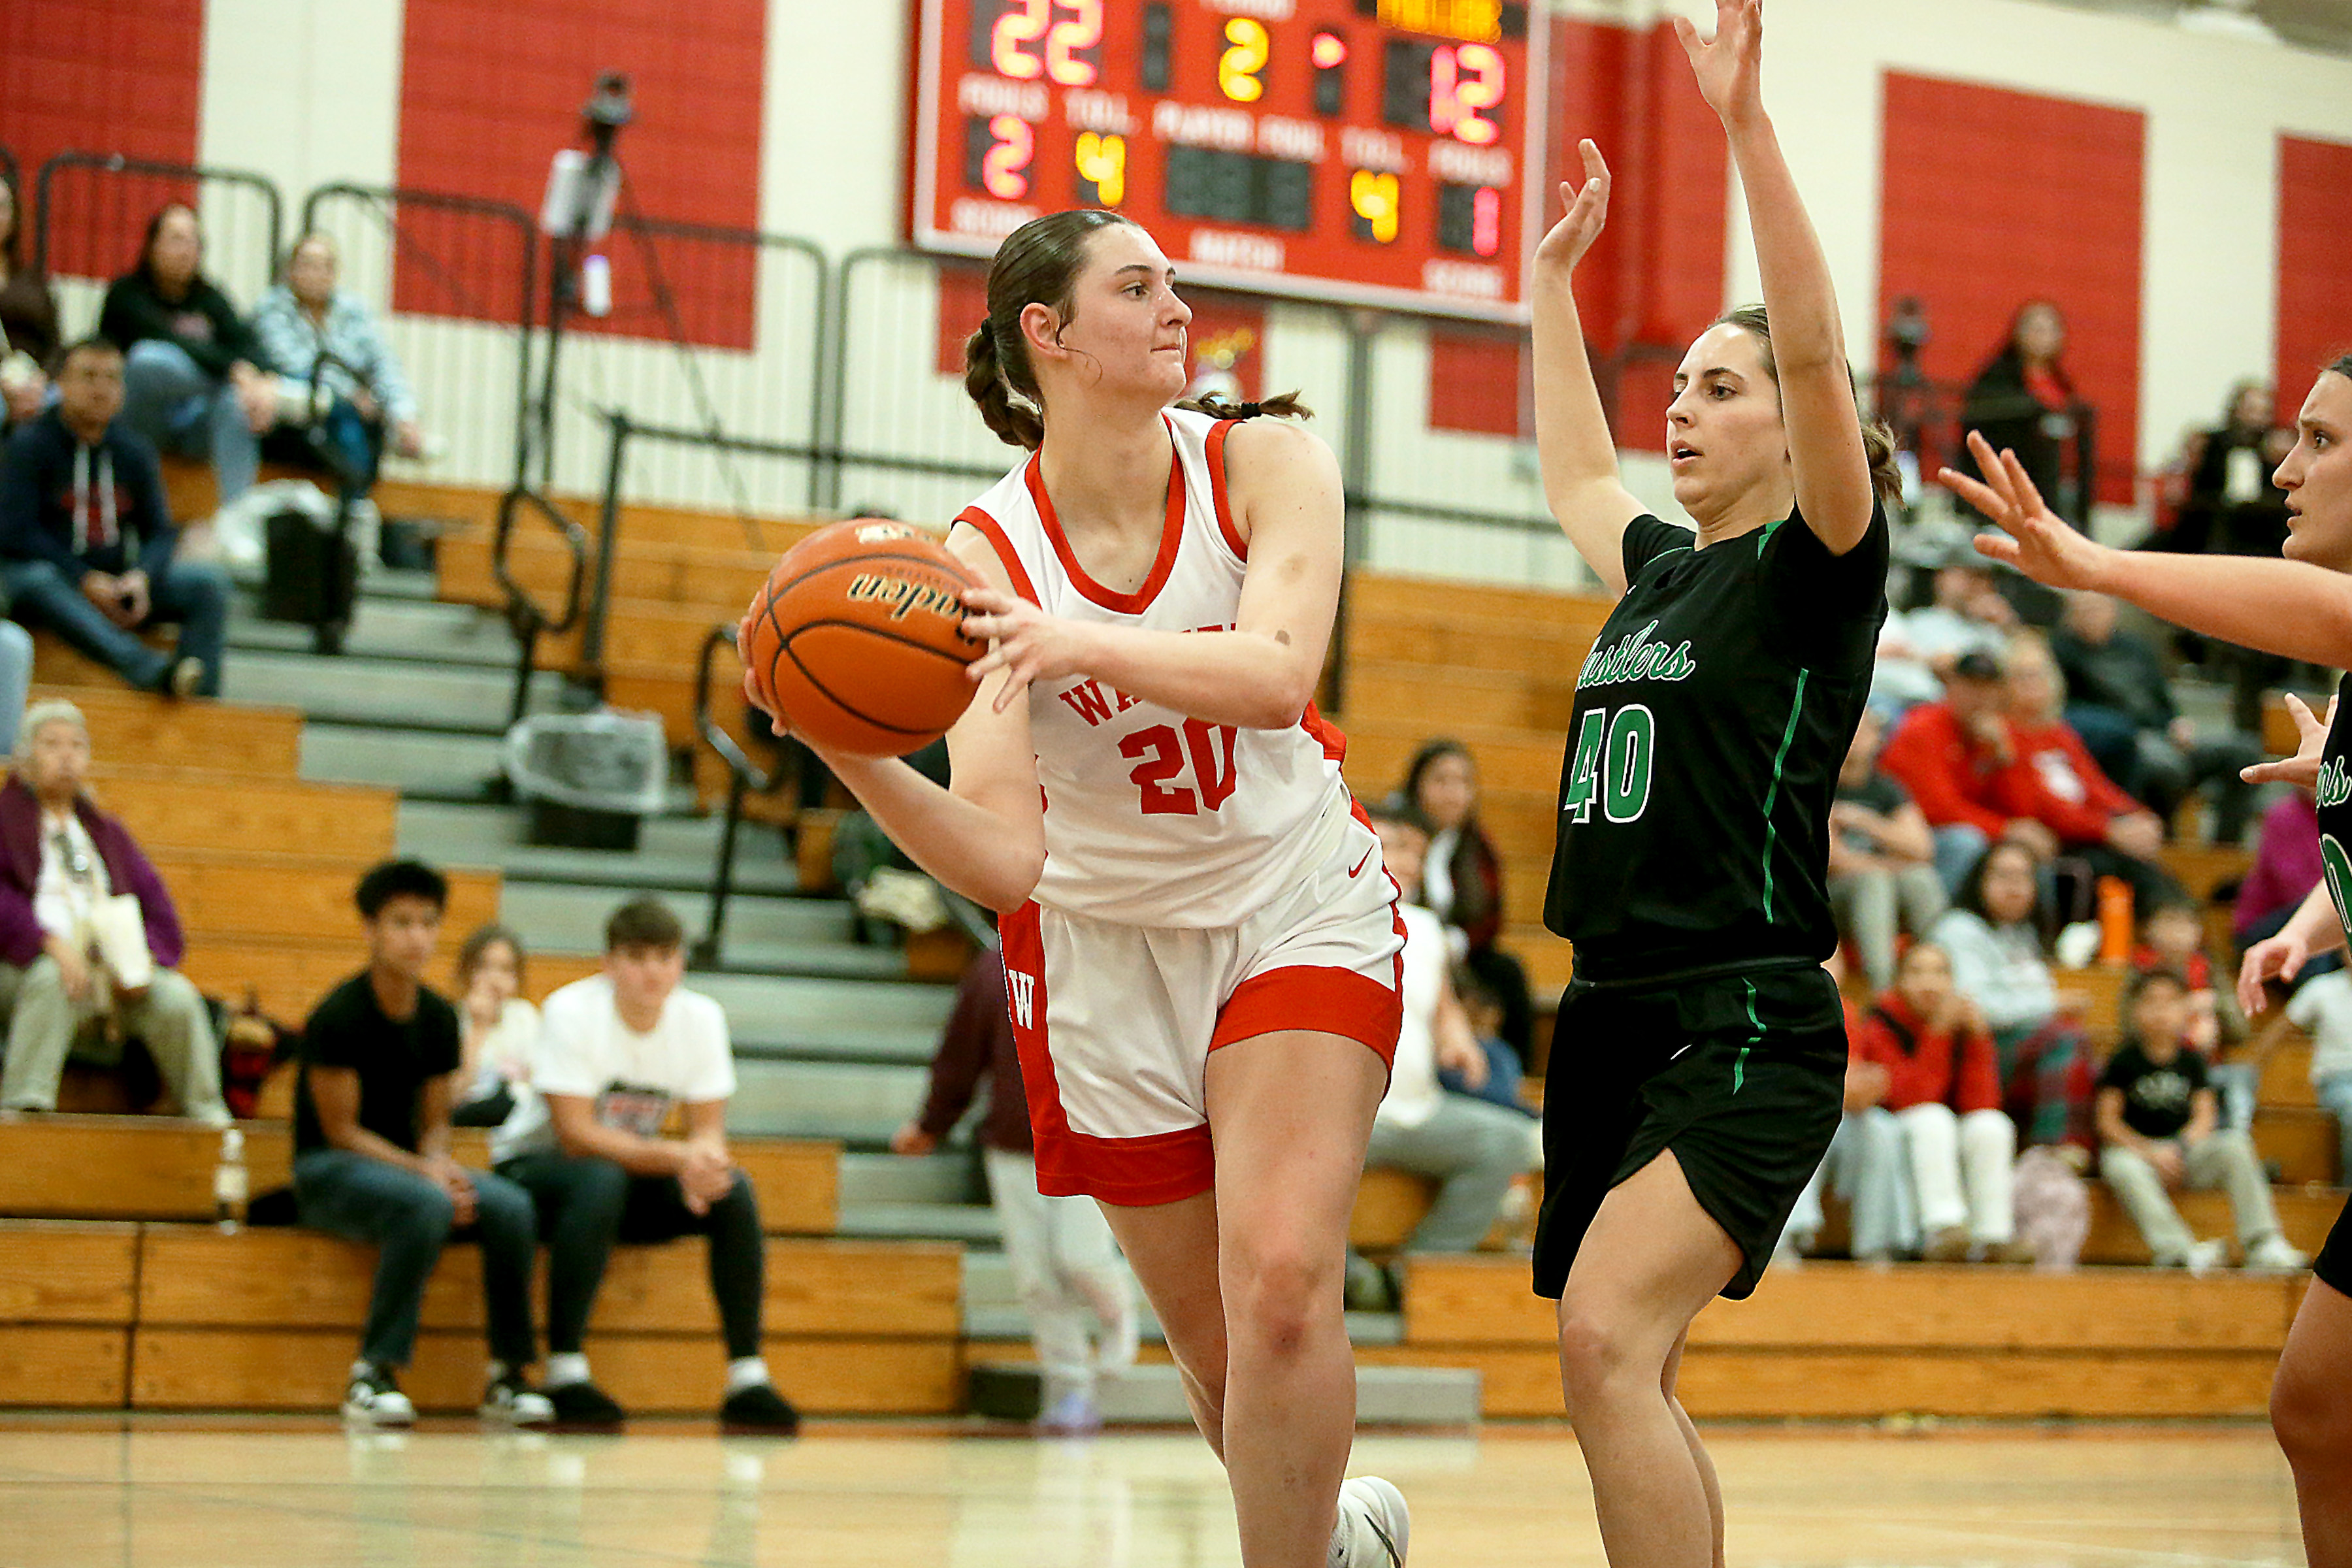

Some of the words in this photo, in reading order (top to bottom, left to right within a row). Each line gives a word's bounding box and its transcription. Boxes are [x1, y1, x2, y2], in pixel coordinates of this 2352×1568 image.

[990, 0, 1104, 86] 22
[1219, 18, 1269, 101] 2
[1429, 42, 1507, 146] 12
[983, 112, 1034, 200] 2
[1075, 131, 1126, 206] 4
[1350, 170, 1399, 242] 4
[1473, 186, 1500, 256] 1
[847, 573, 975, 640] aden
[1118, 717, 1237, 815] 20
[1564, 704, 1654, 824] 40
[1008, 969, 1035, 1030] W
